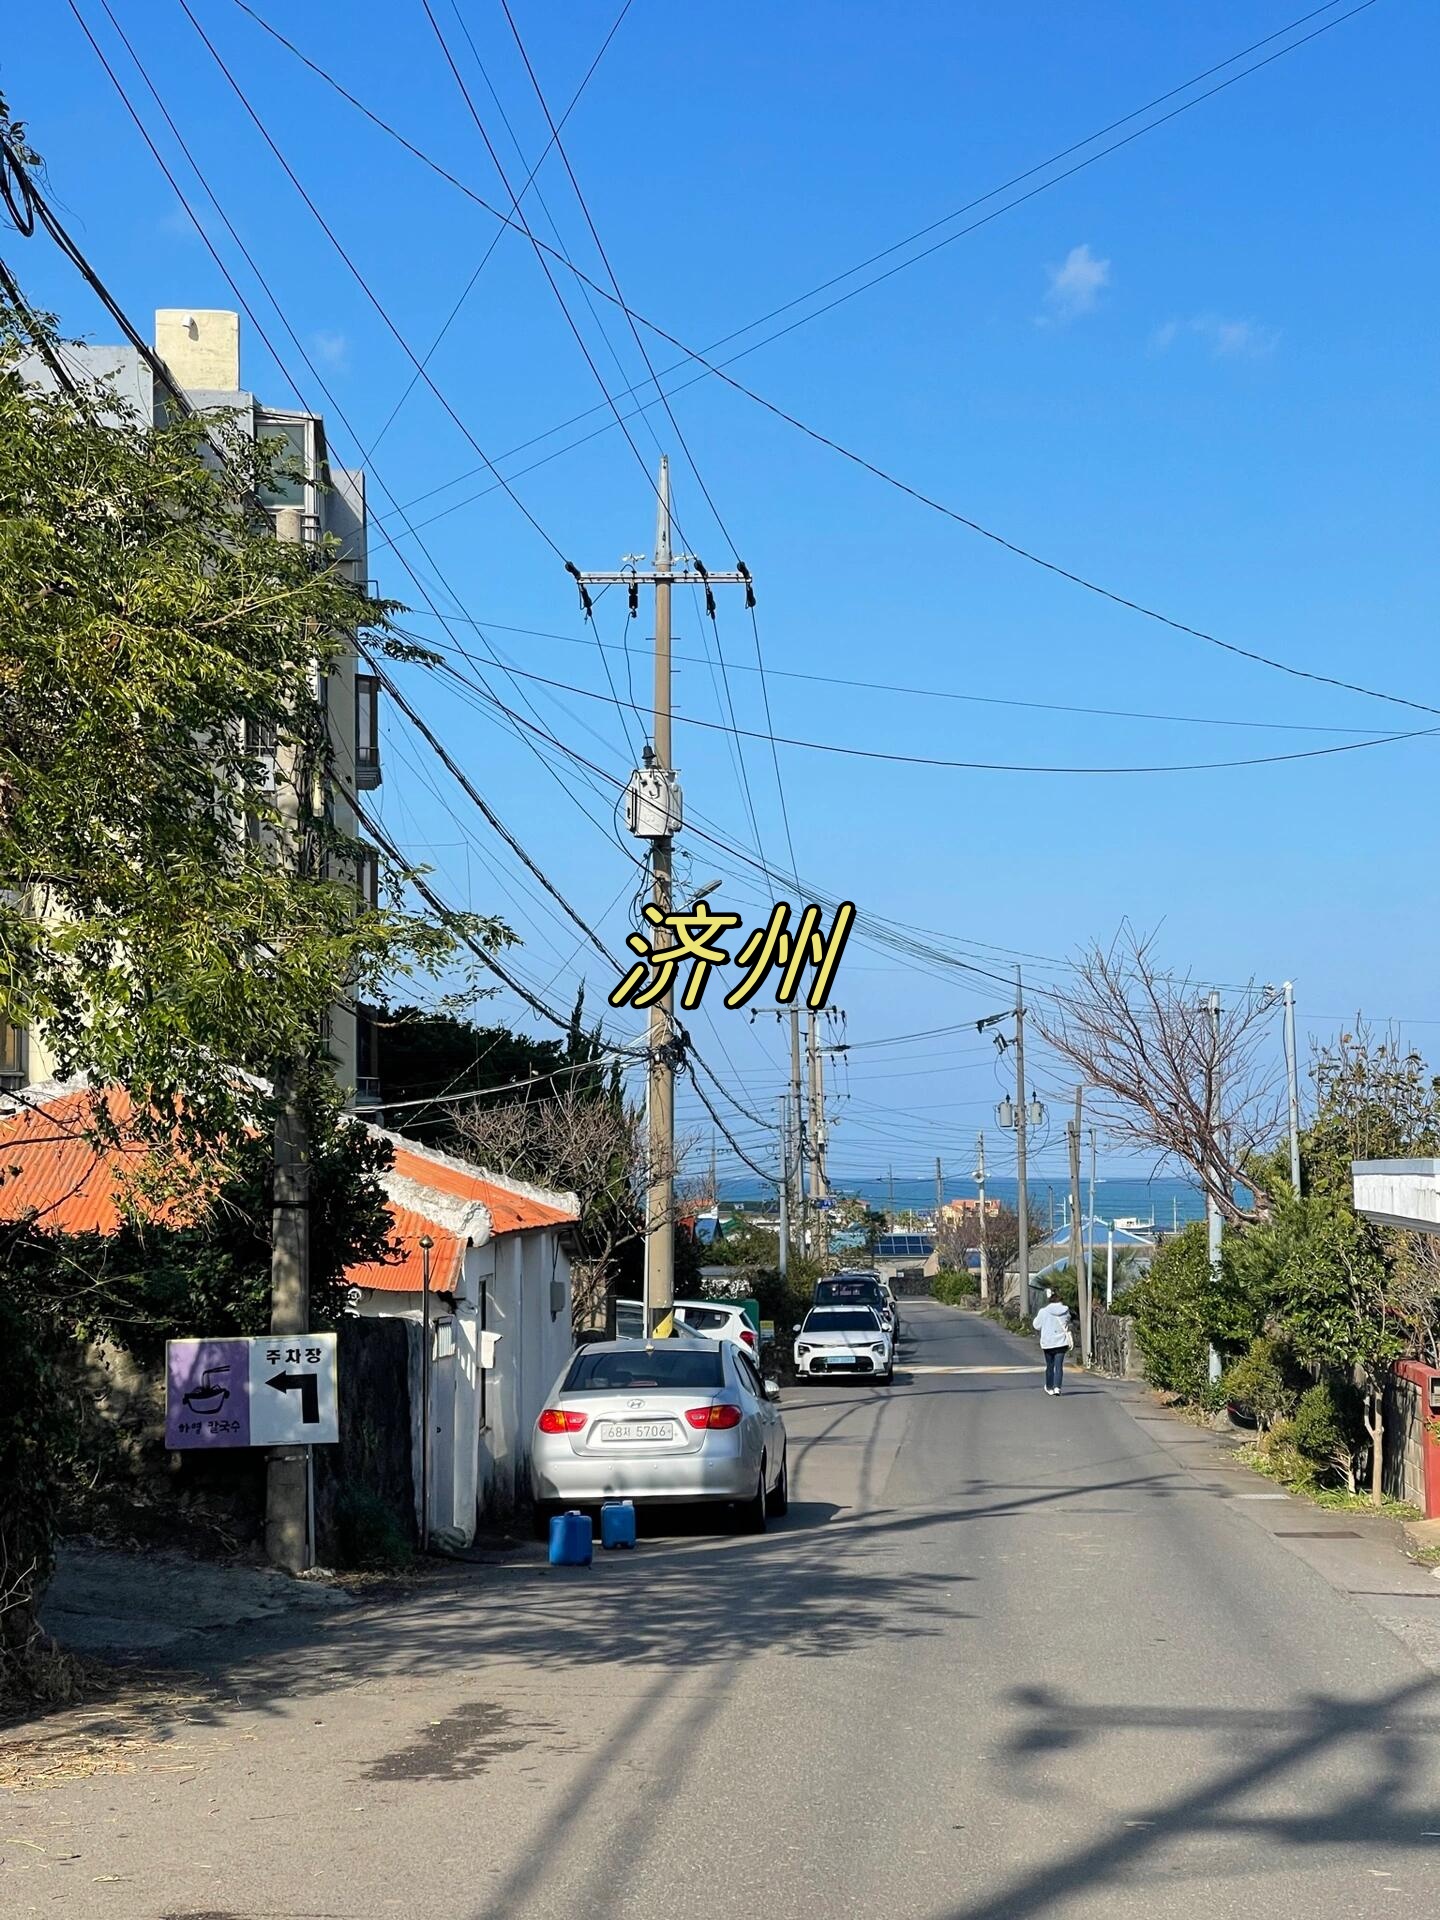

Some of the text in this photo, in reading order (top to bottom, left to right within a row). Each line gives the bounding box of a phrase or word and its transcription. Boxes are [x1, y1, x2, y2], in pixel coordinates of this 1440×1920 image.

[266, 1348, 322, 1365] 주차장
[207, 1420, 241, 1434] 칼국수
[636, 1425, 666, 1438] 5706
